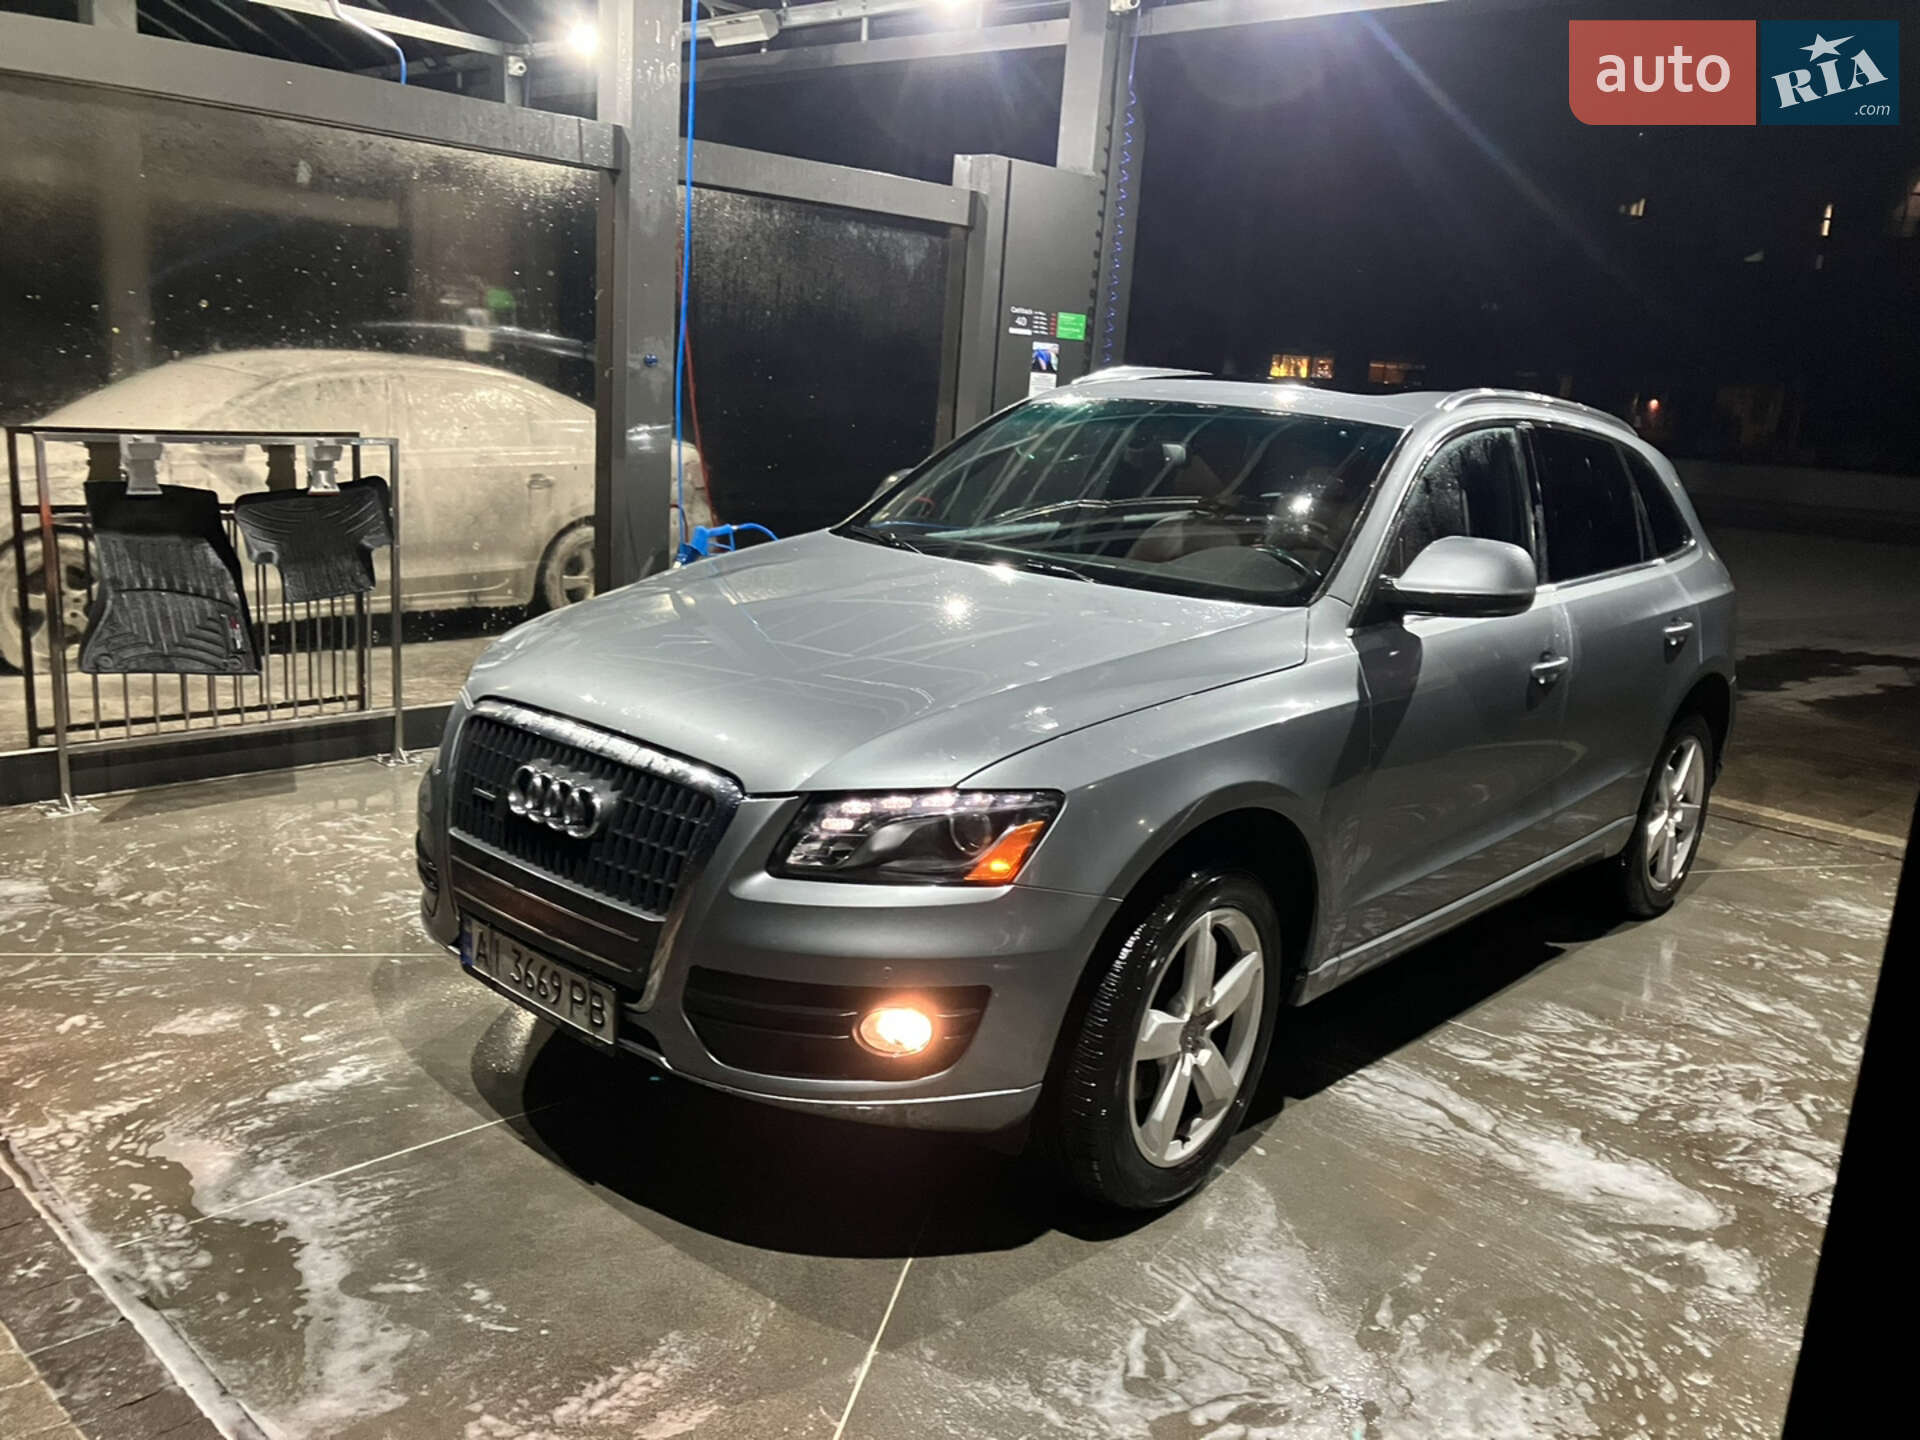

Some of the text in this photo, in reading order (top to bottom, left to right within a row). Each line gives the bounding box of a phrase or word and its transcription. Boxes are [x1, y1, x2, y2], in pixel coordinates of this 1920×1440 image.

[474, 929, 607, 1028] AI 3669 PB
